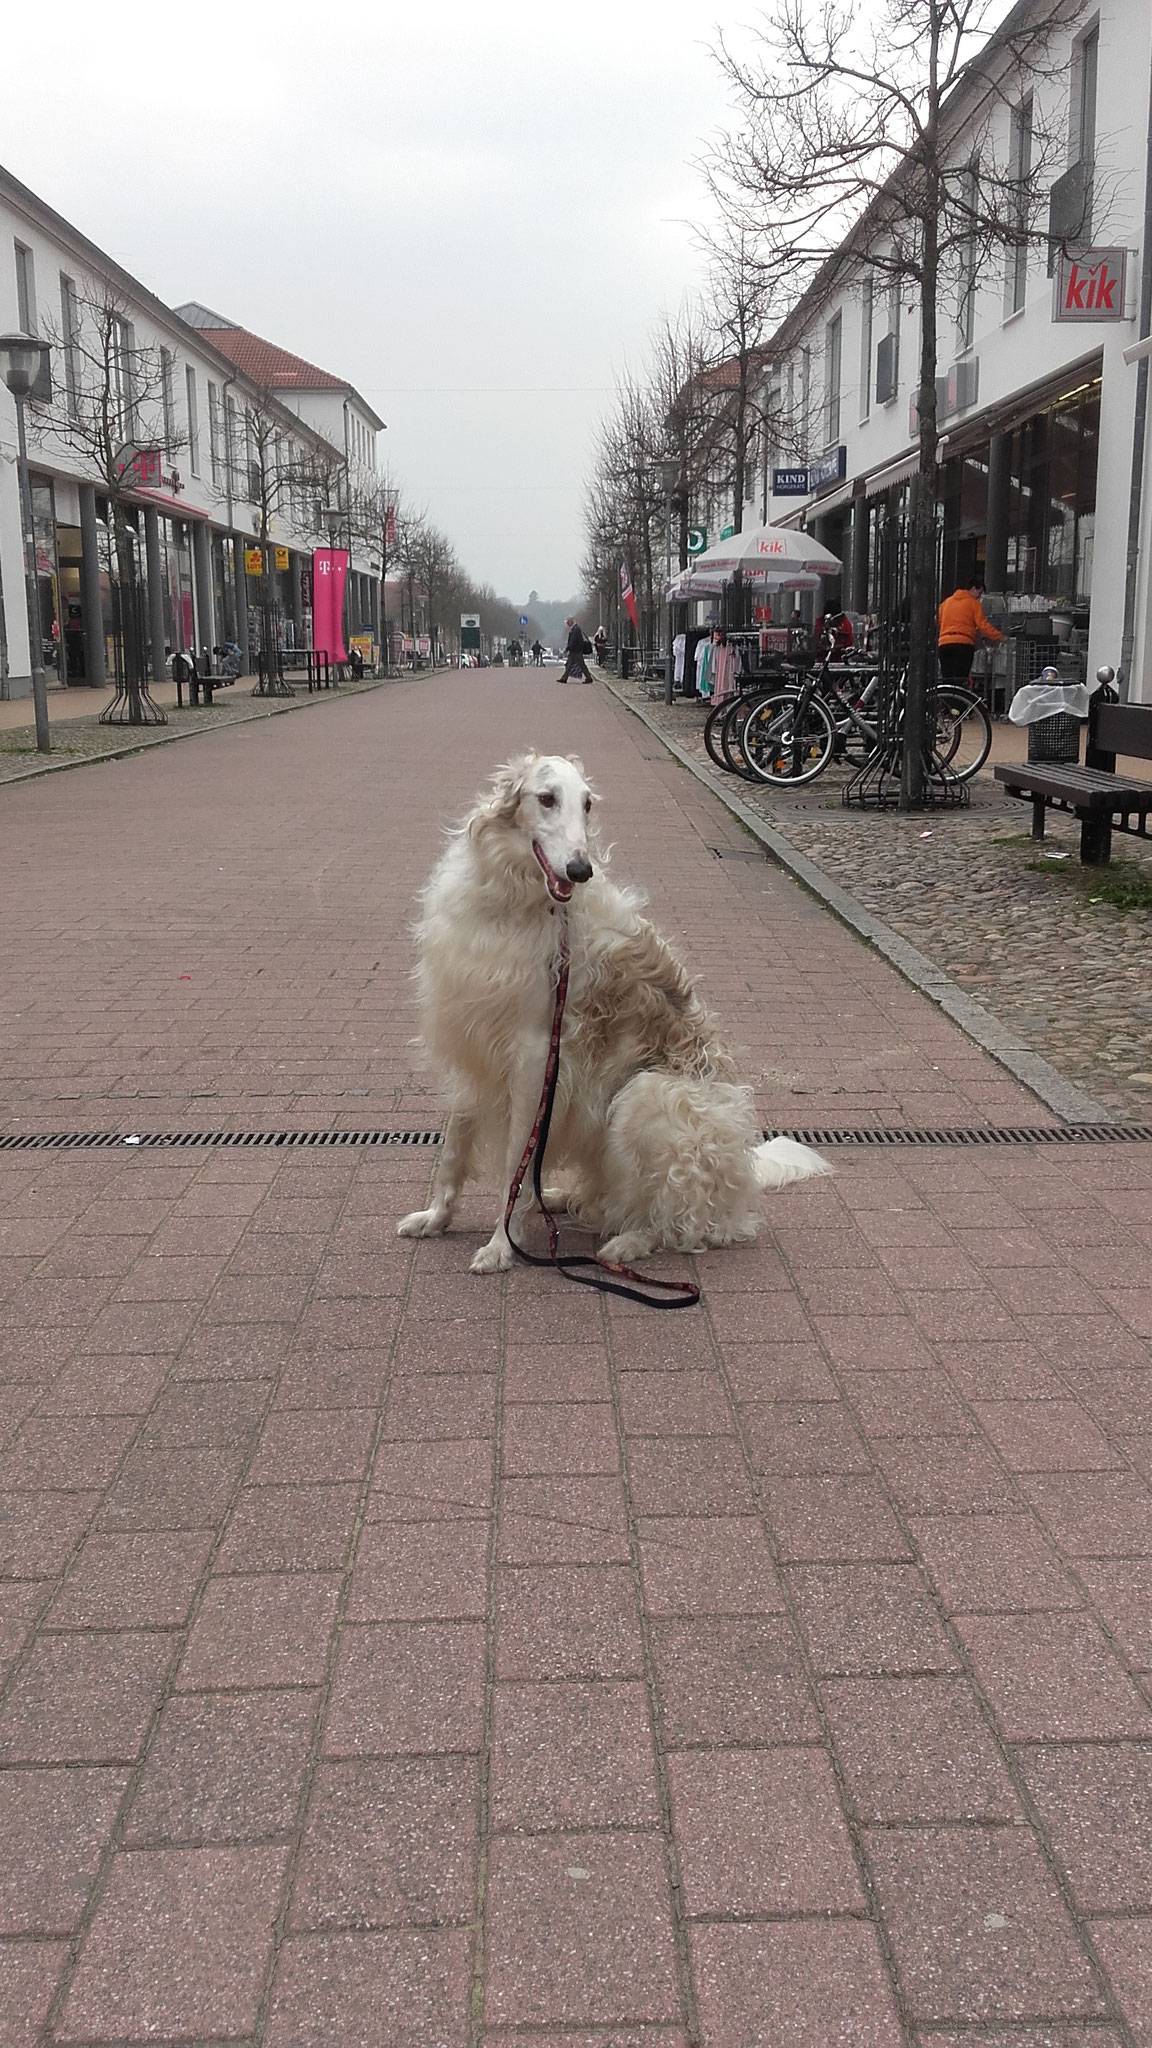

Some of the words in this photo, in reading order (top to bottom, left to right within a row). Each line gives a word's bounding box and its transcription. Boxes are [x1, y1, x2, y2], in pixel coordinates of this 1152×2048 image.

[1065, 256, 1118, 309] kik
[776, 474, 806, 484] KIND
[760, 542, 783, 553] kik
